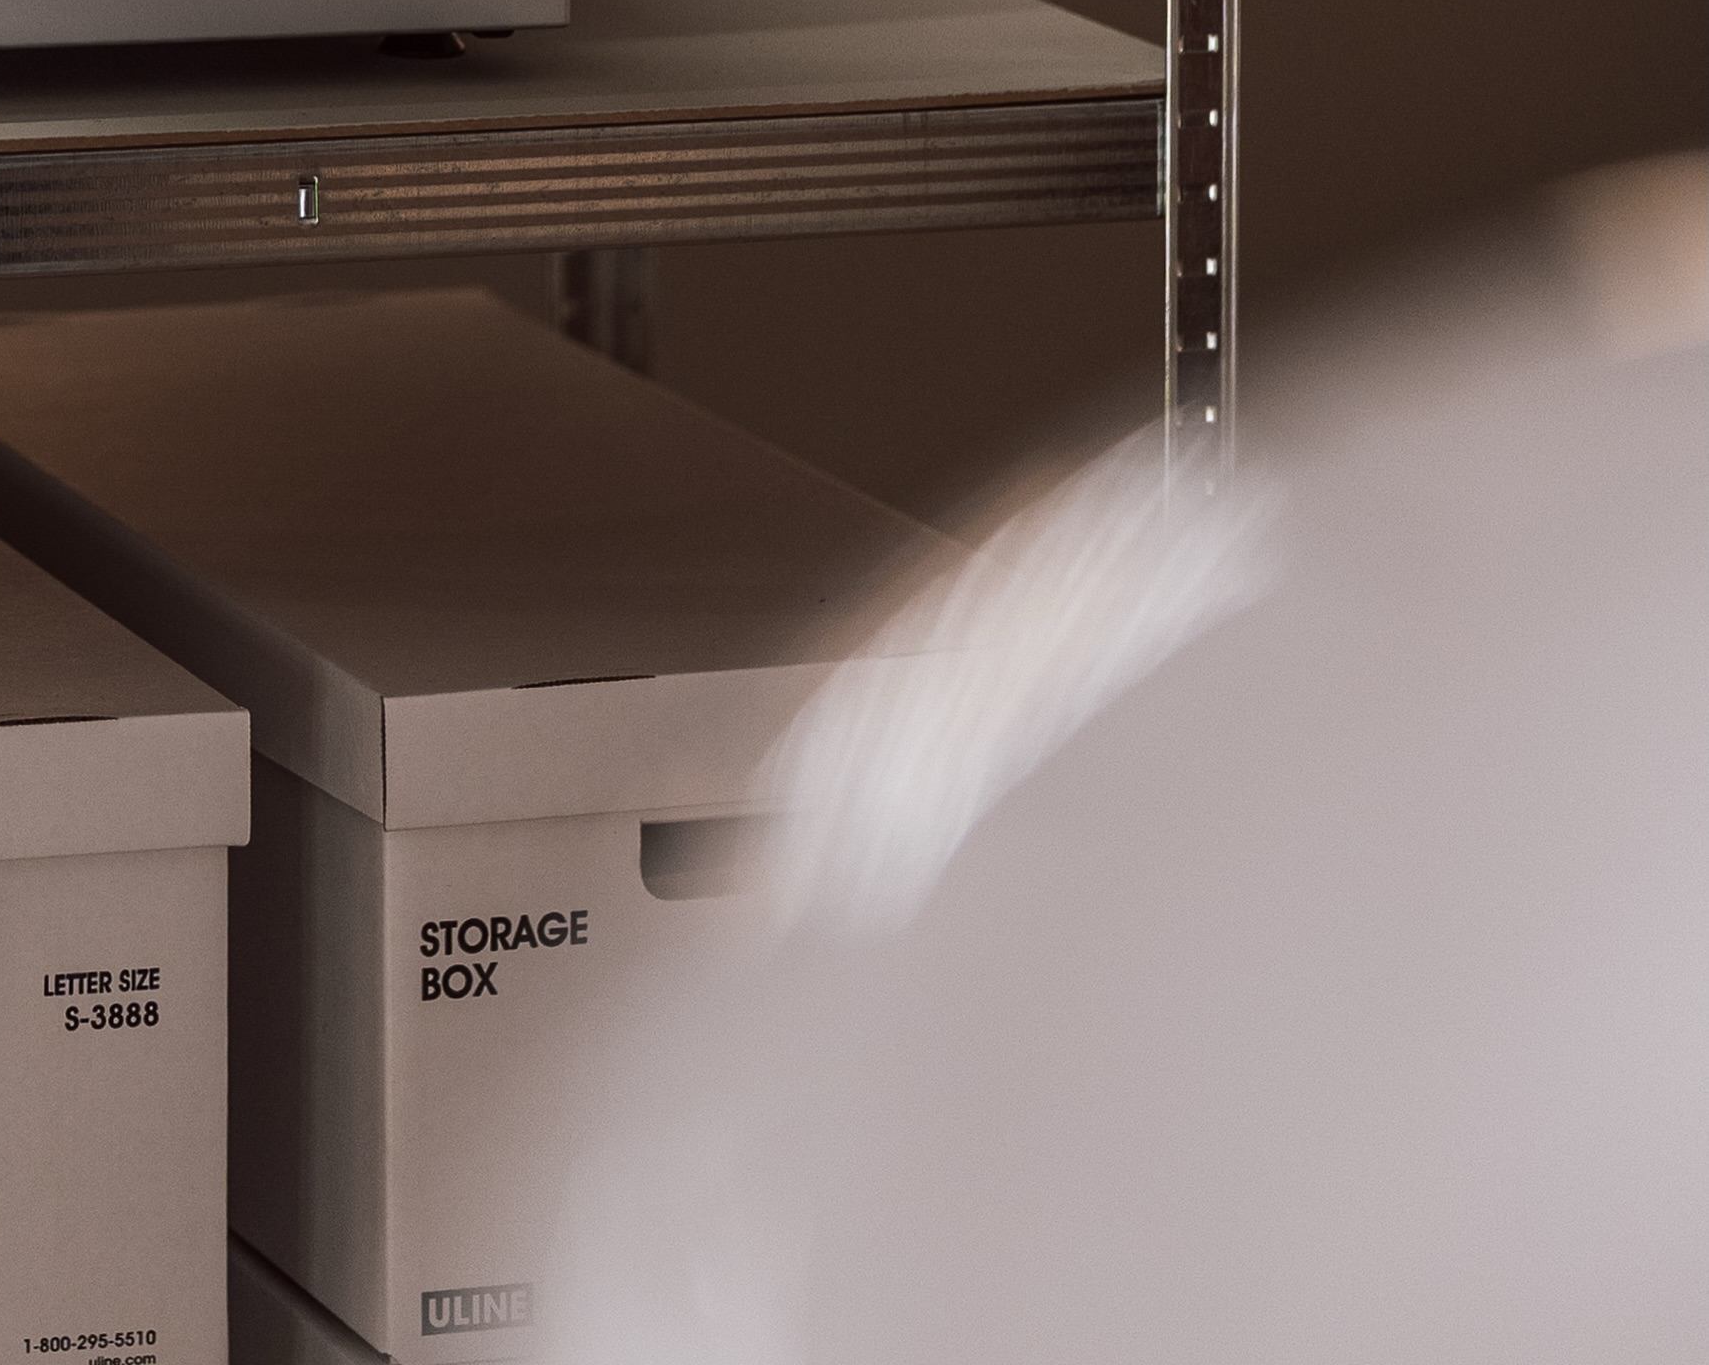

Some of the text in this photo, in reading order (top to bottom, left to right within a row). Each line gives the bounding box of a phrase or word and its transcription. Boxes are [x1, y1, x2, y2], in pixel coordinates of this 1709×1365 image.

[420, 910, 587, 957] STORAGE
[44, 968, 160, 996] LETTER SIZE
[422, 962, 497, 1001] BOX
[65, 1001, 159, 1031] S-3888
[428, 1291, 529, 1328] ULINE
[24, 1330, 156, 1353] 1-800-295-5510
